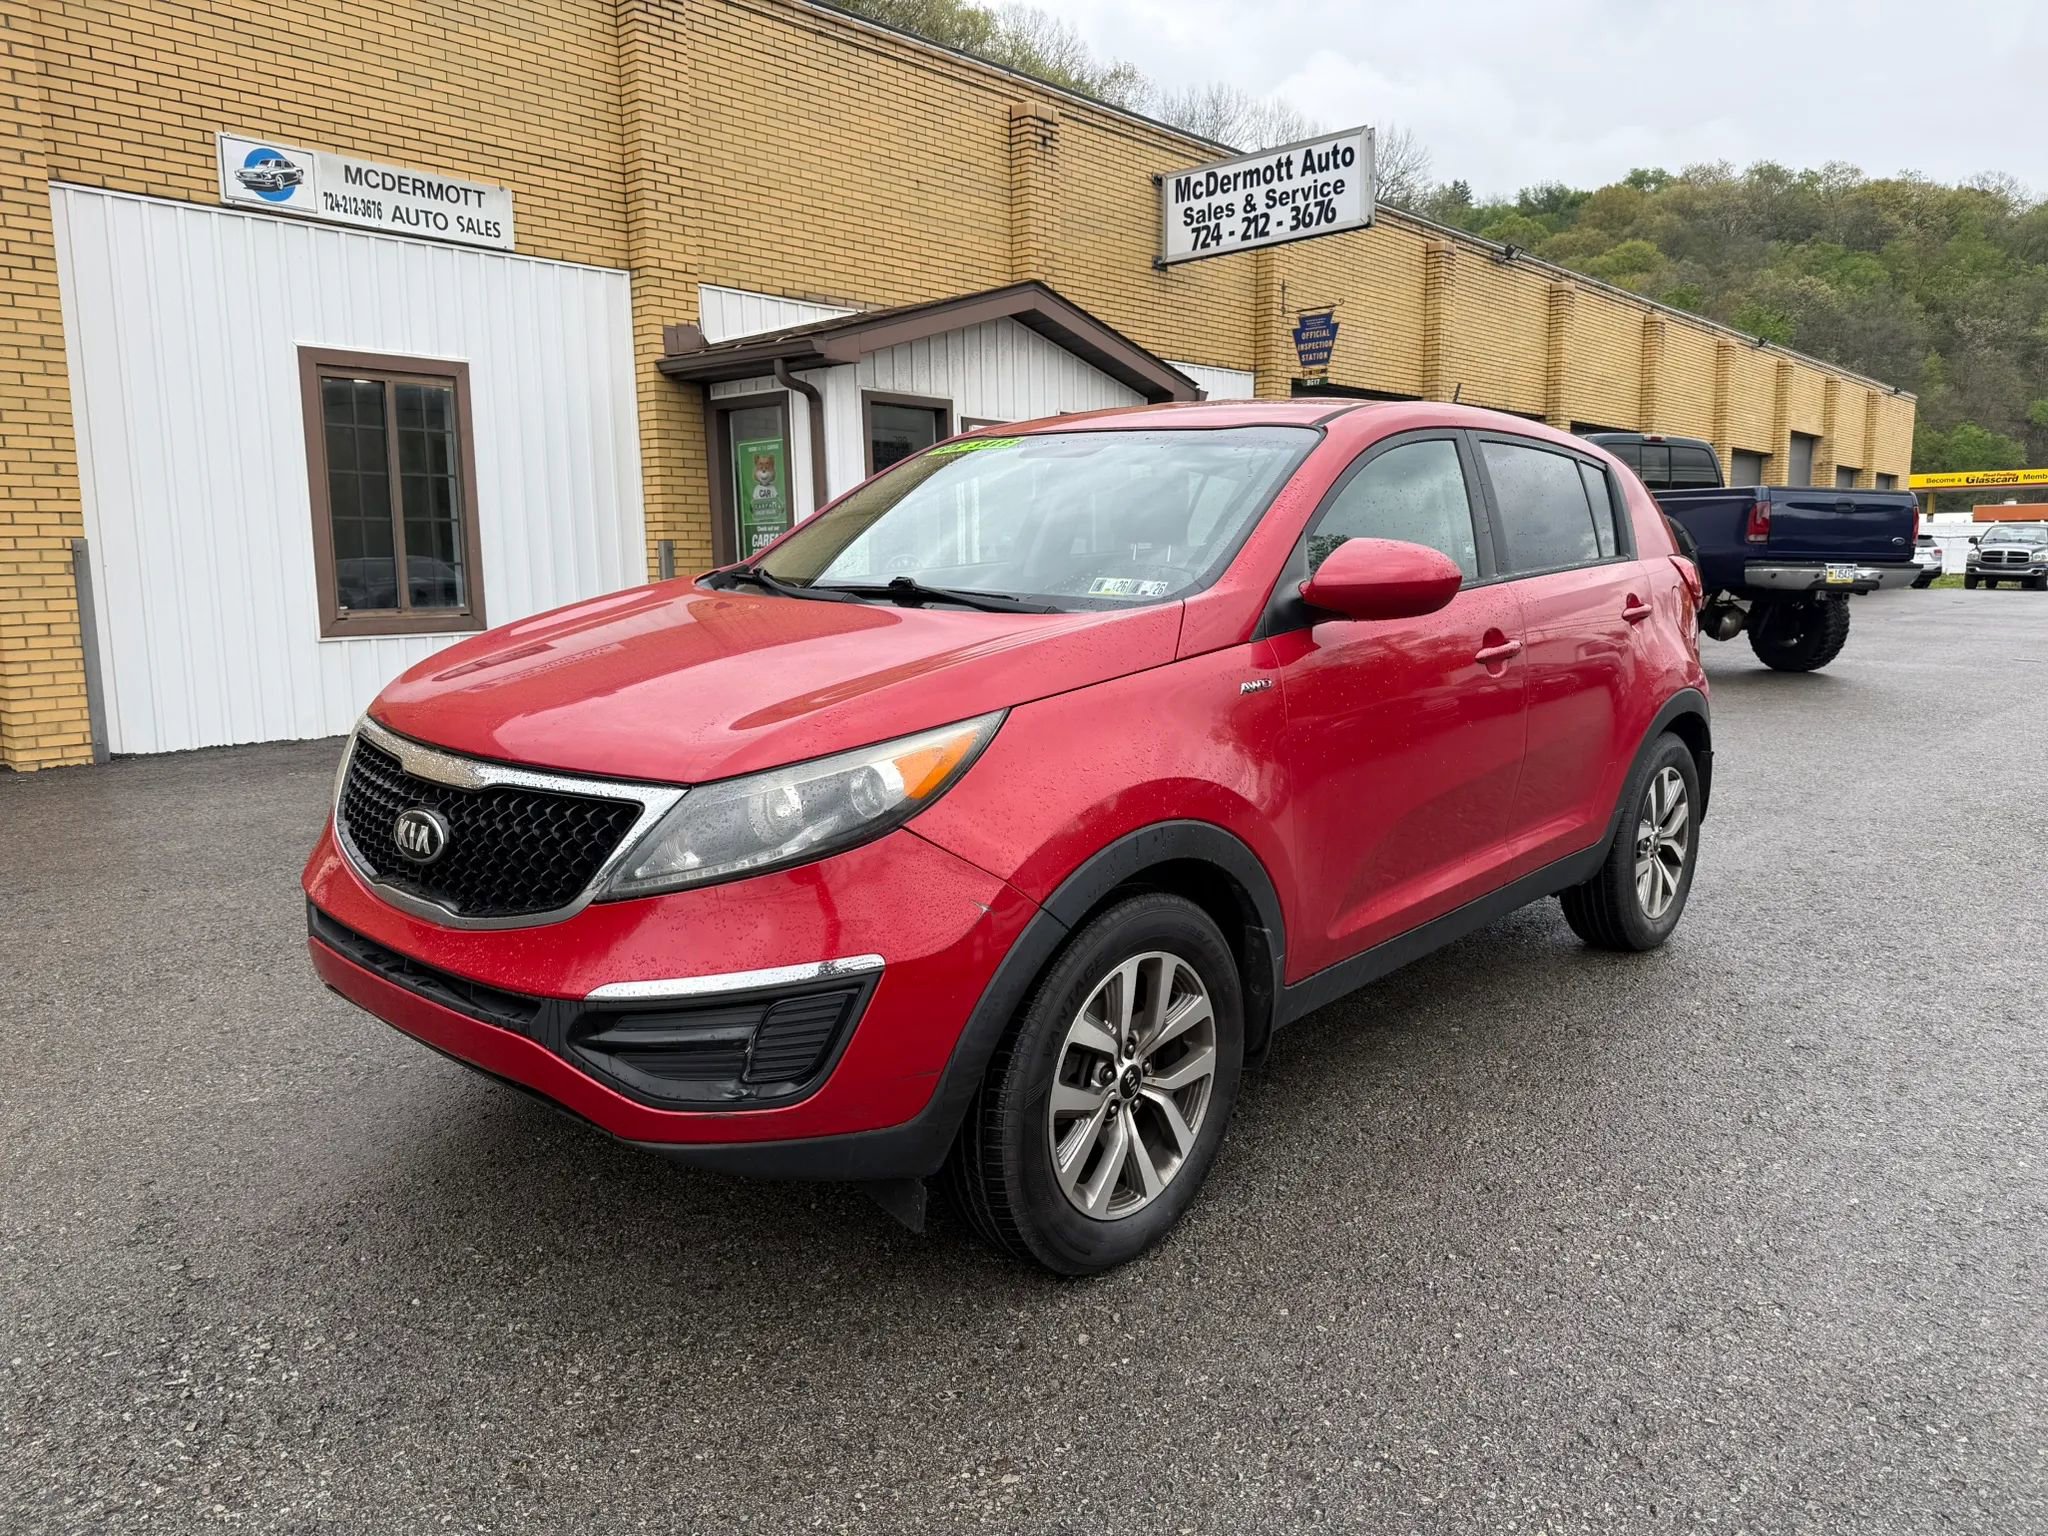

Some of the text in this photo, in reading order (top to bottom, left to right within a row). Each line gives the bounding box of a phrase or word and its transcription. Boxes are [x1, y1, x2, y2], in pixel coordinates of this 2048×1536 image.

[1175, 143, 1355, 204] McDermott Auto
[344, 164, 486, 208] MCDERMOTT
[323, 191, 383, 220] 724-212-3676
[1183, 178, 1346, 227] Sales & Service
[391, 205, 501, 238] AUTO SALES
[1301, 329, 1330, 340] OFFICIAL
[1298, 340, 1333, 351] INSPECTION
[1302, 352, 1328, 361] STATION
[1966, 475, 2019, 484] Glasscard
[759, 489, 772, 498] CAR
[752, 533, 783, 547] CARF
[1240, 679, 1272, 695] AWD
[397, 818, 431, 855] KIA
[1125, 1069, 1138, 1095] KIA
